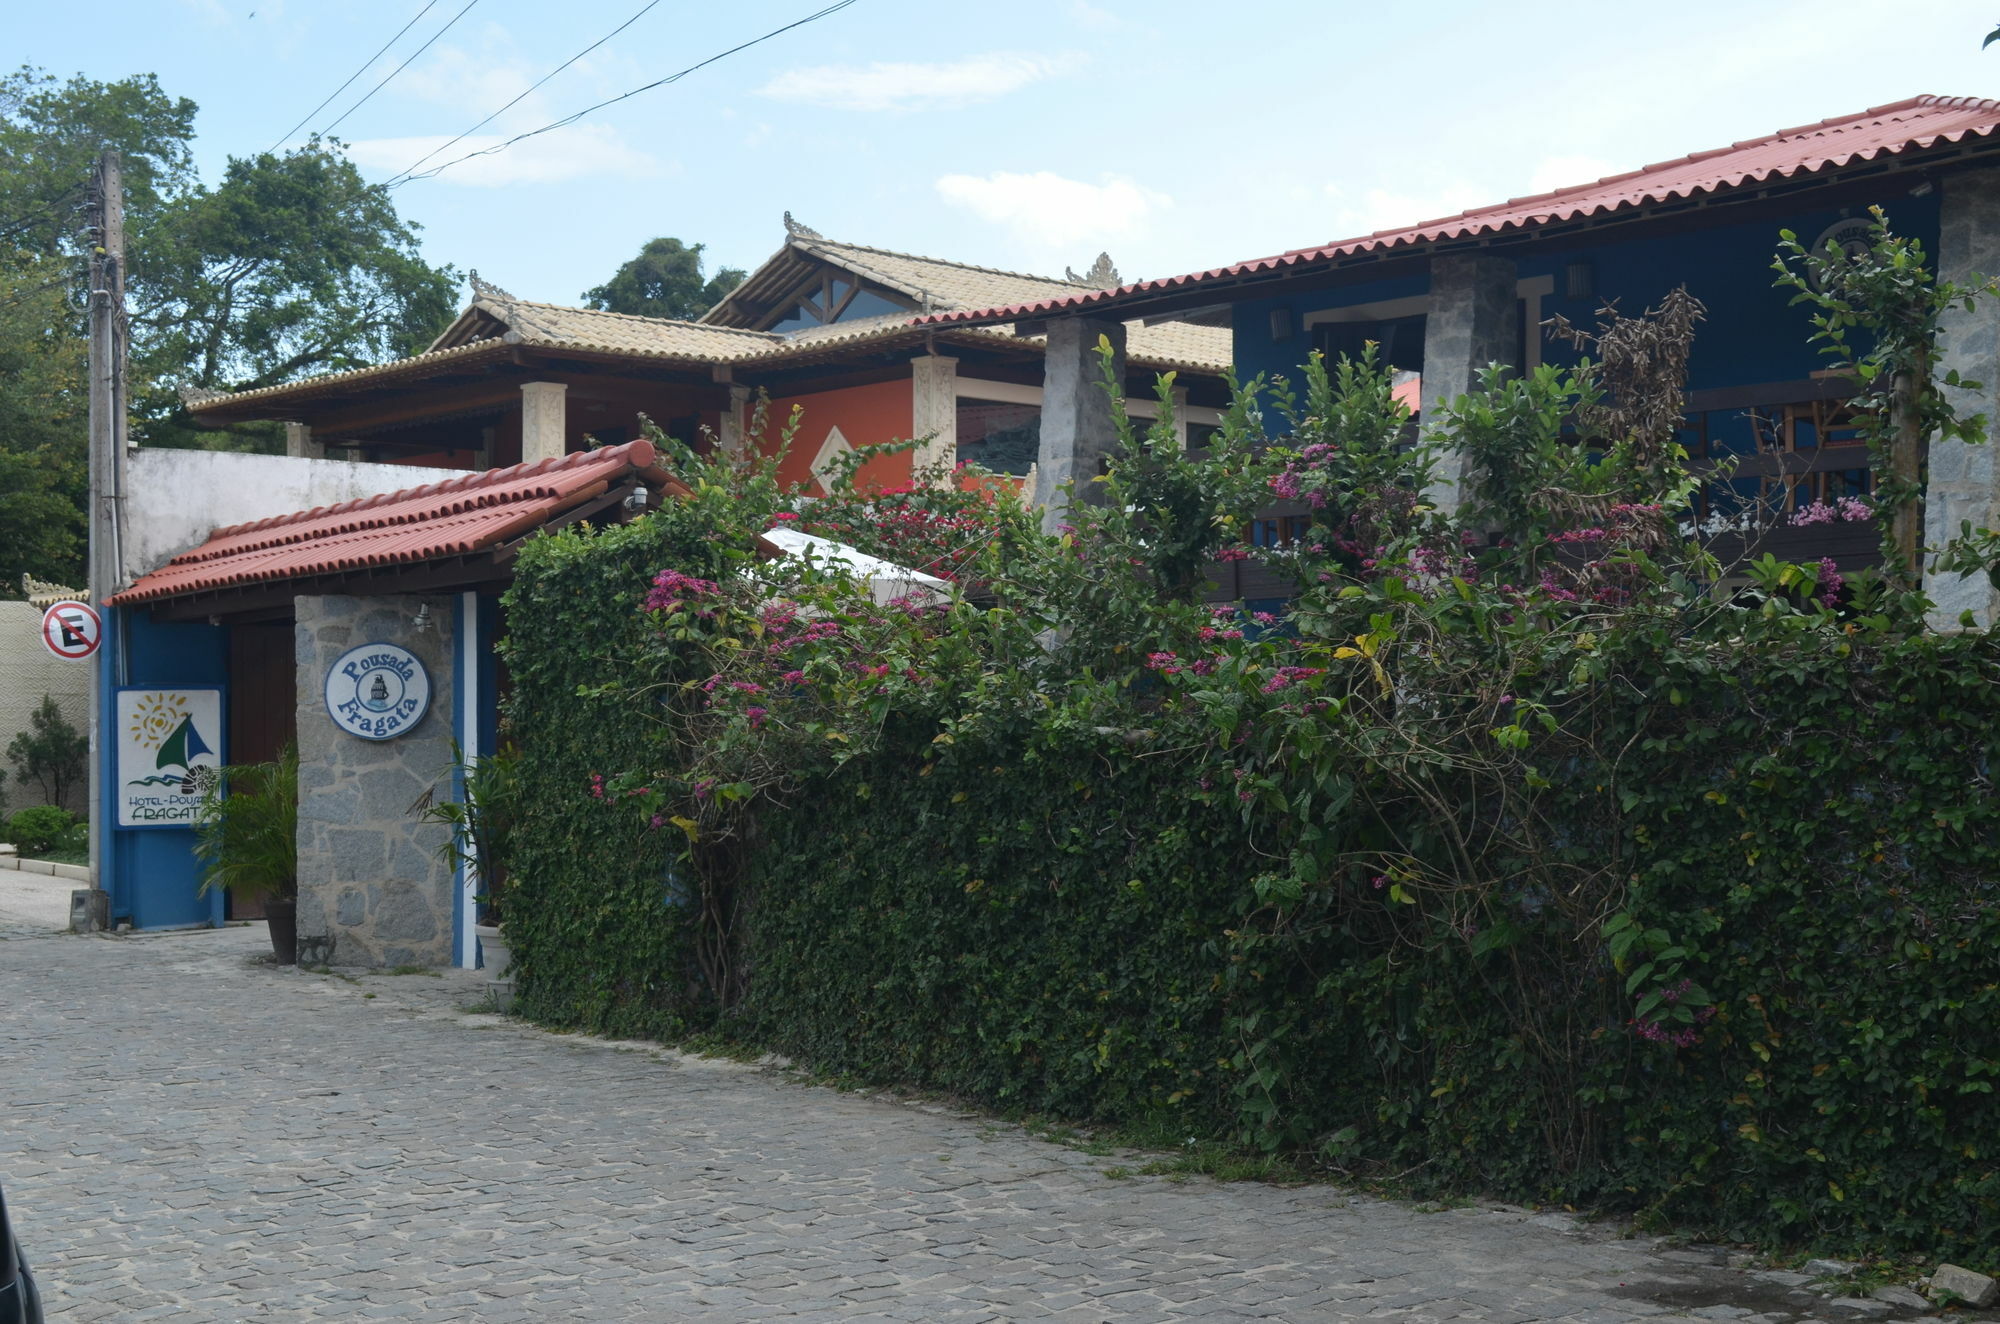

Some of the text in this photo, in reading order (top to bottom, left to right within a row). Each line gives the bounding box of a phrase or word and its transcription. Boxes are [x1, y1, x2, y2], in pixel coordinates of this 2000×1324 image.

[60, 614, 85, 648] E
[342, 654, 414, 682] Pousada
[337, 697, 418, 737] Fragata
[131, 806, 209, 821] FRAGAT
